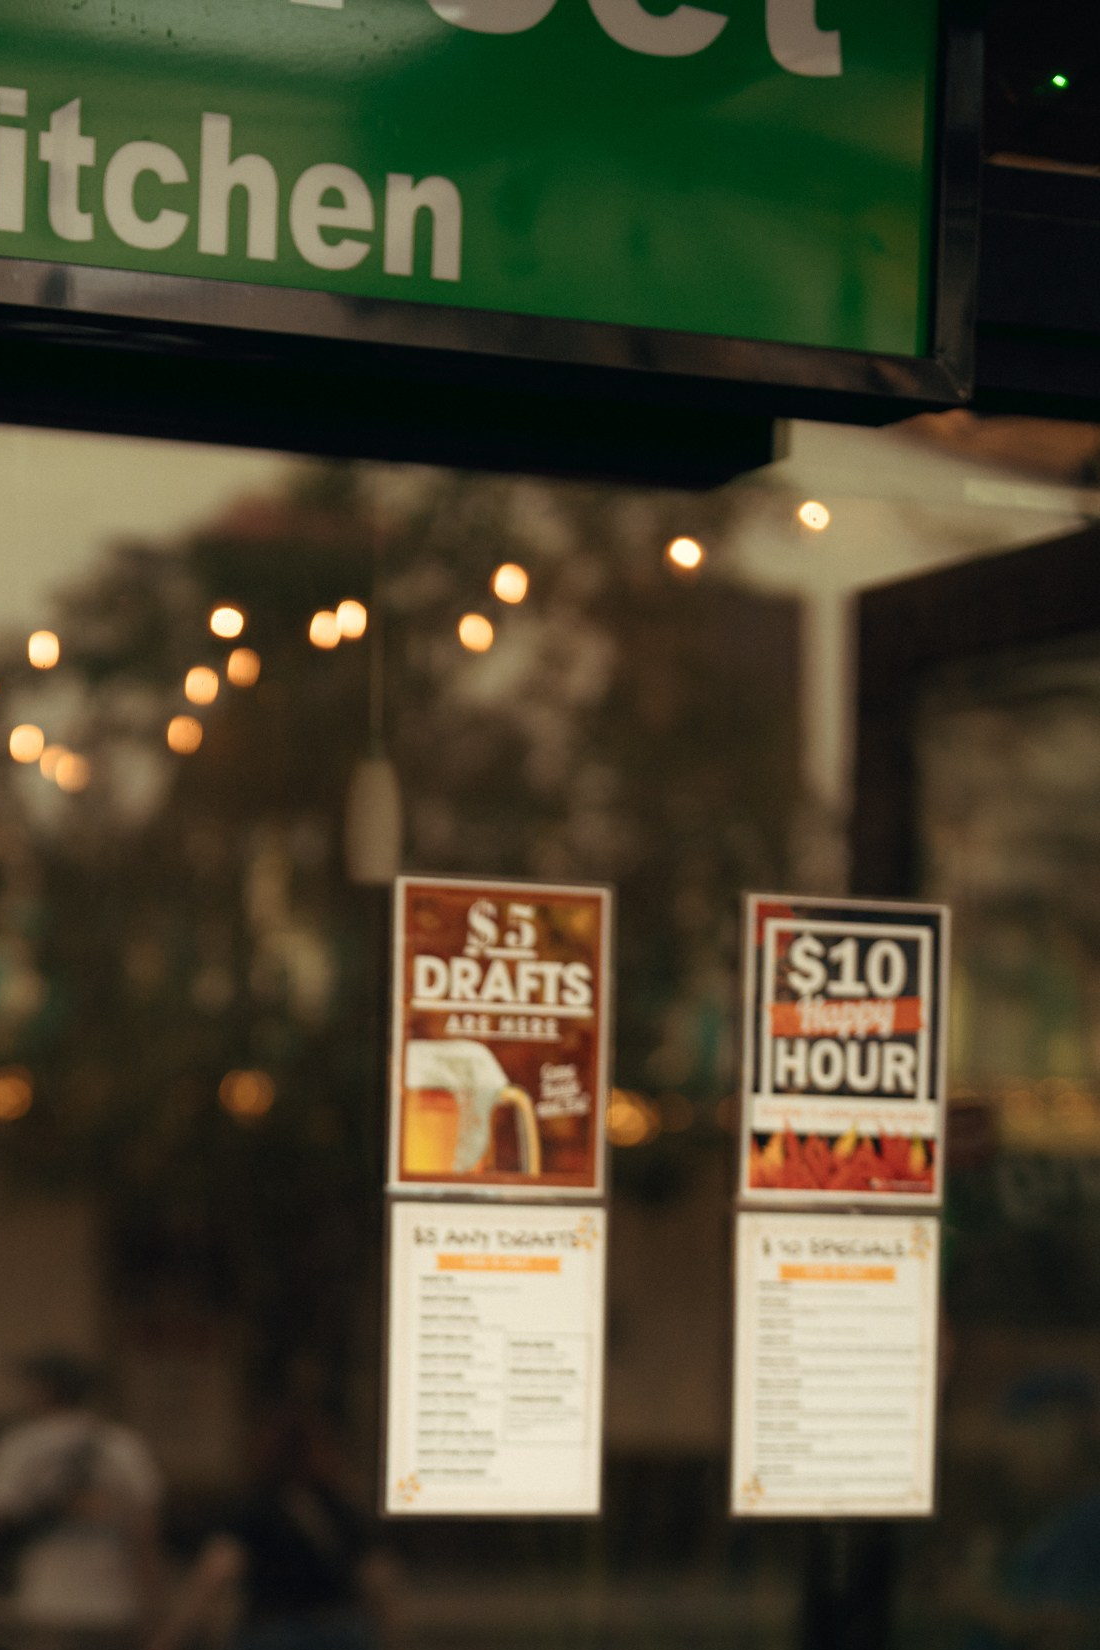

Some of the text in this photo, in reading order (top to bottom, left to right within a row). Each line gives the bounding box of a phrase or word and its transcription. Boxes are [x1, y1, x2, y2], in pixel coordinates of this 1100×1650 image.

[464, 899, 538, 953] $5
[413, 953, 594, 1008] DRAFTS
[787, 931, 908, 998] $10
[797, 995, 897, 1039] Happy
[773, 1039, 917, 1093] HOUR
